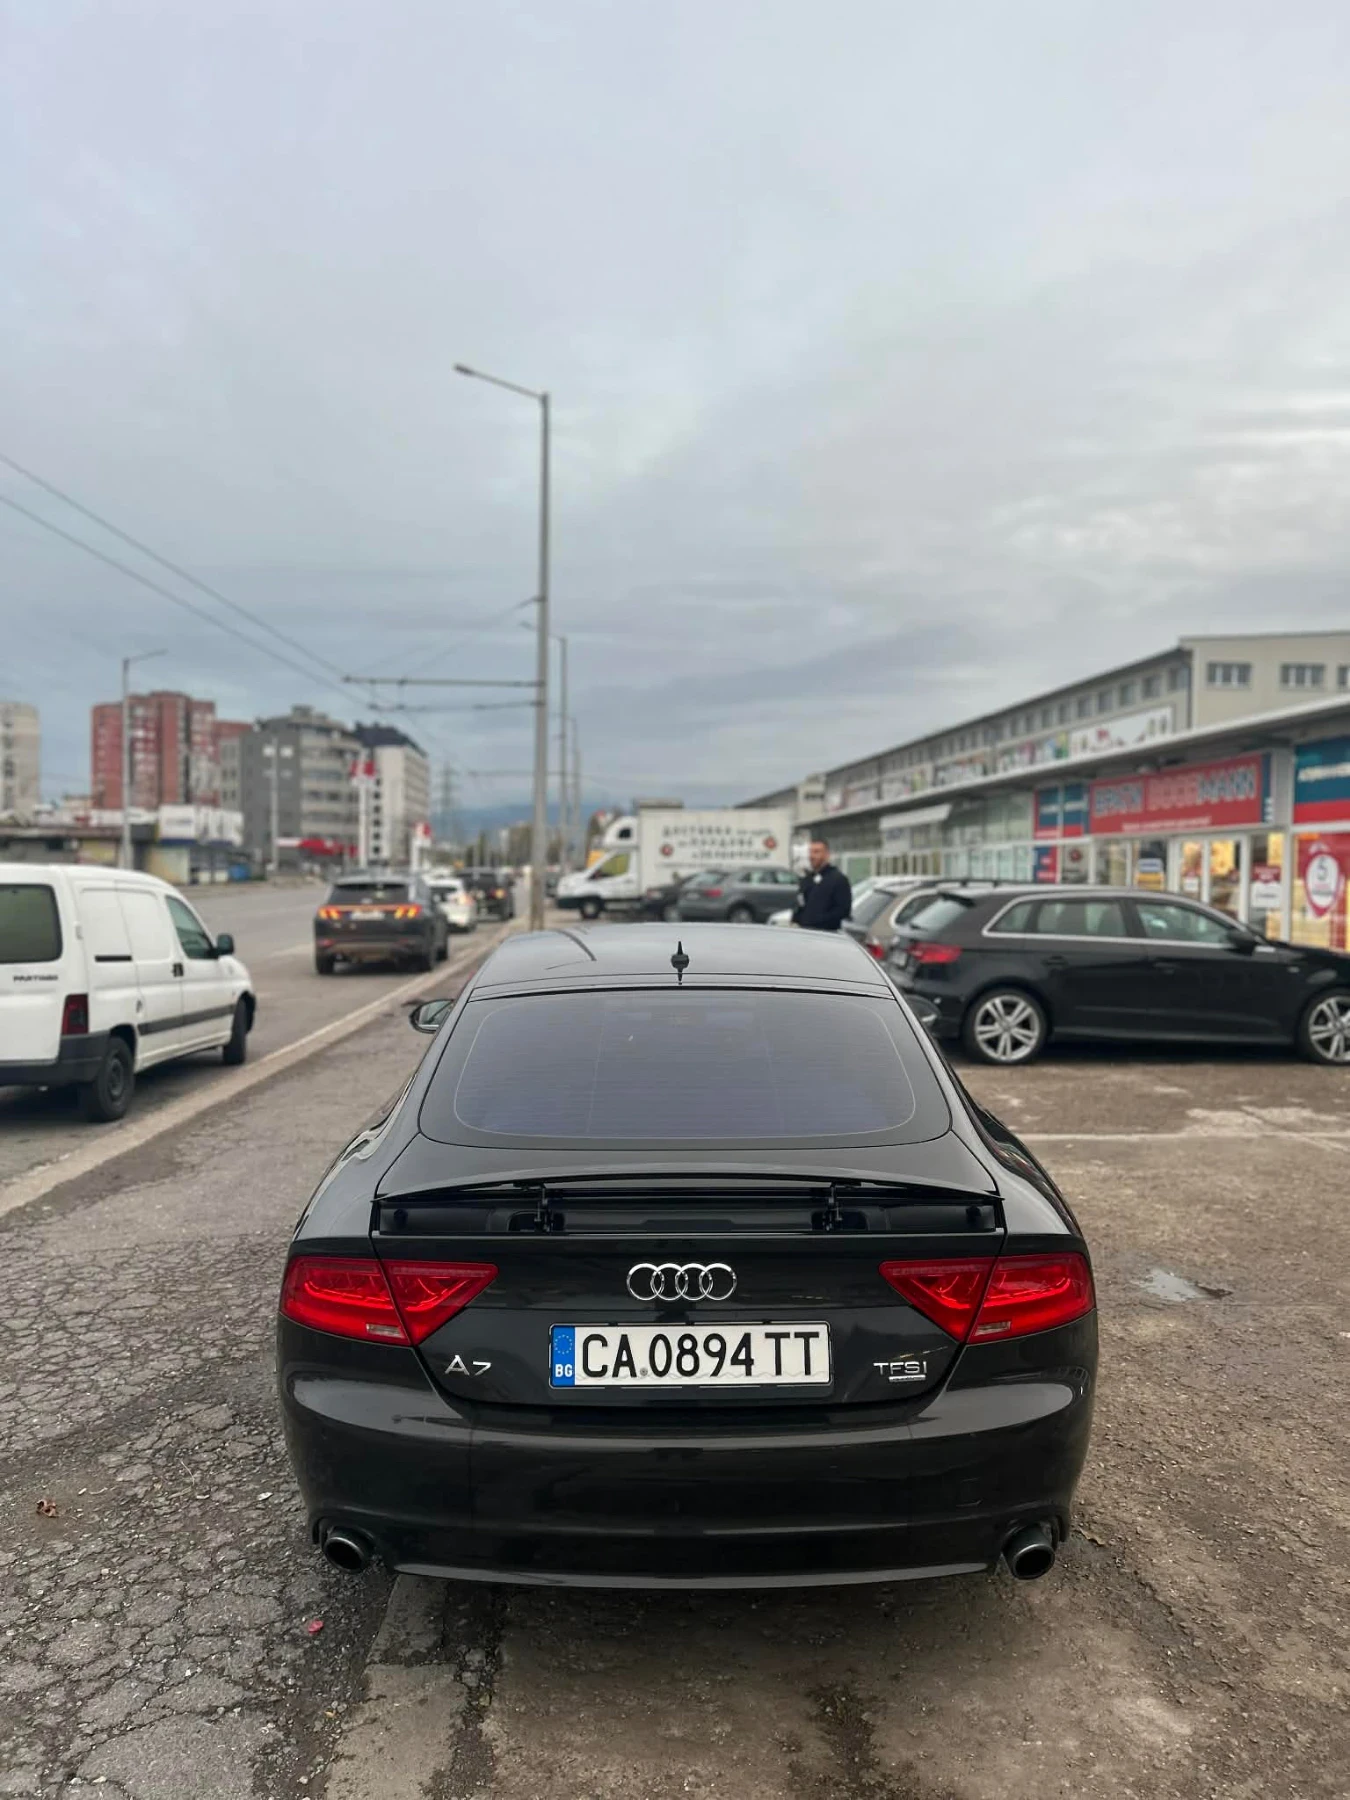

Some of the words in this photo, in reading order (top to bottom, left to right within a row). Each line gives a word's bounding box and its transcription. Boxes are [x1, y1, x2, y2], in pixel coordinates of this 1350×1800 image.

[582, 1333, 637, 1378] CA
[648, 1332, 754, 1377] 0894
[765, 1331, 819, 1376] TT
[444, 1354, 492, 1376] A7
[555, 1363, 573, 1378] BG
[873, 1361, 928, 1375] TFSI
